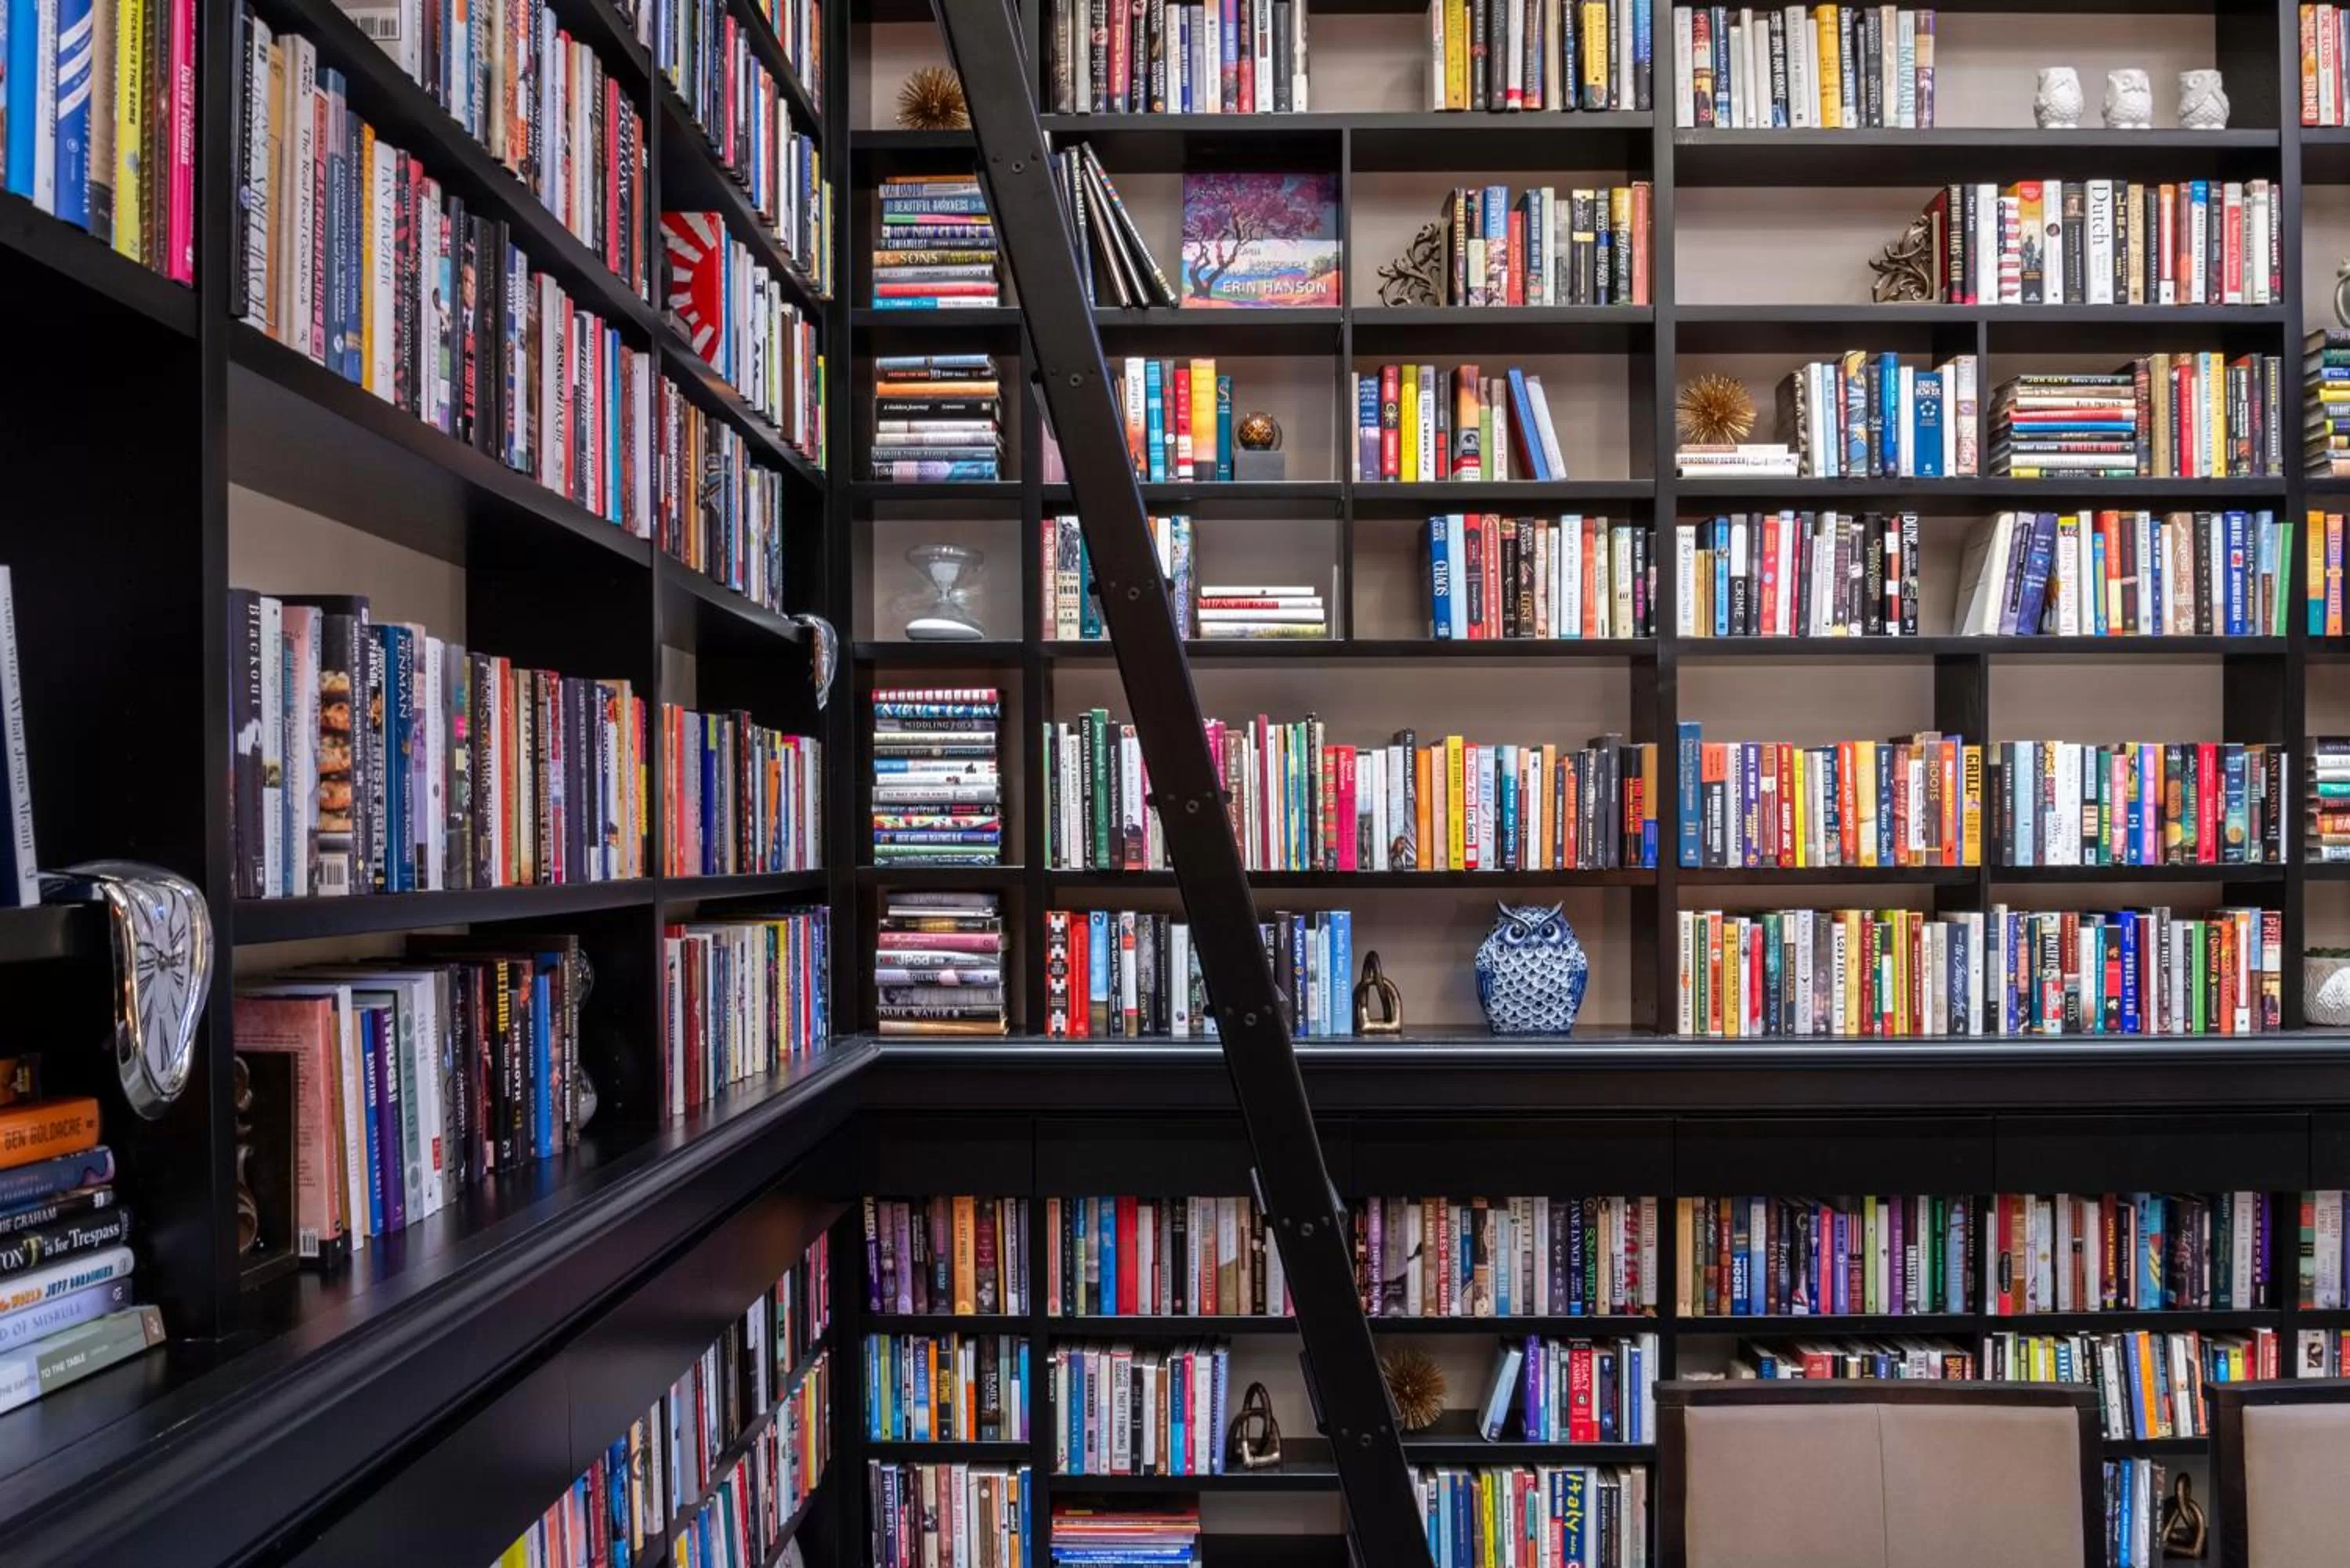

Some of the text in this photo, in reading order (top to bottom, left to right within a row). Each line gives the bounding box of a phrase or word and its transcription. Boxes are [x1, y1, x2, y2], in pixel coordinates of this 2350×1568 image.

[2092, 186, 2109, 246] Dutch
[1222, 281, 1327, 295] ERIN HANSON
[1434, 560, 1449, 596] CHAOS
[1929, 761, 1939, 800] ROOTS
[1966, 754, 1979, 794] GRILL
[2045, 934, 2059, 969] PACIFIC
[69, 1222, 120, 1252] Trespass
[1564, 1473, 1583, 1532] Italy
